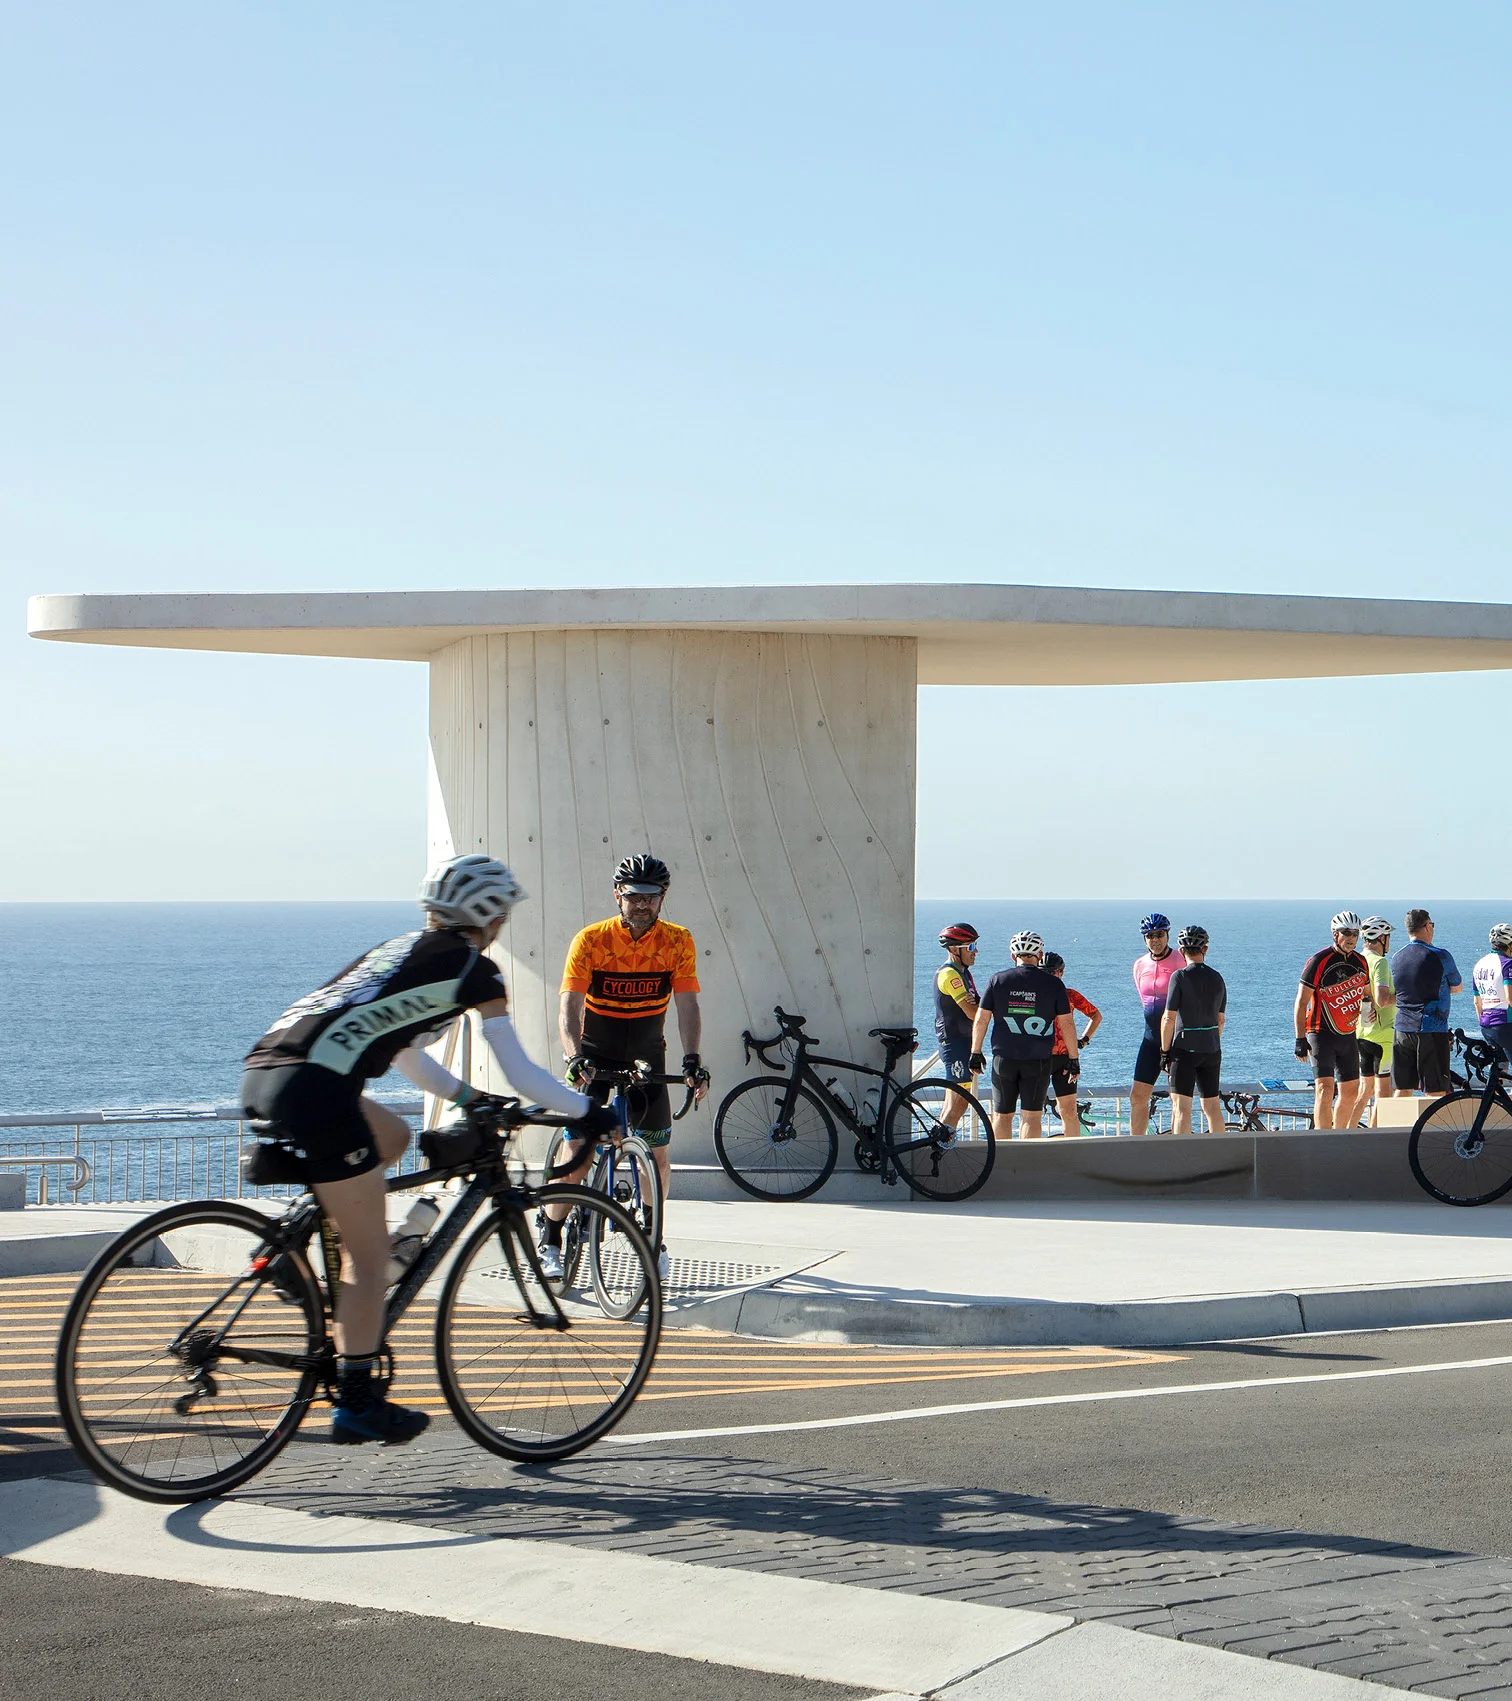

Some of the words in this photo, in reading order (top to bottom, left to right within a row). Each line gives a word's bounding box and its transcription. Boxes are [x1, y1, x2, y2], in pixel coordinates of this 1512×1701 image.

[602, 980, 661, 994] CYCOLOGY
[1329, 986, 1365, 1009] LONDO
[1340, 999, 1362, 1015] PRID
[329, 995, 440, 1051] PRIMAL
